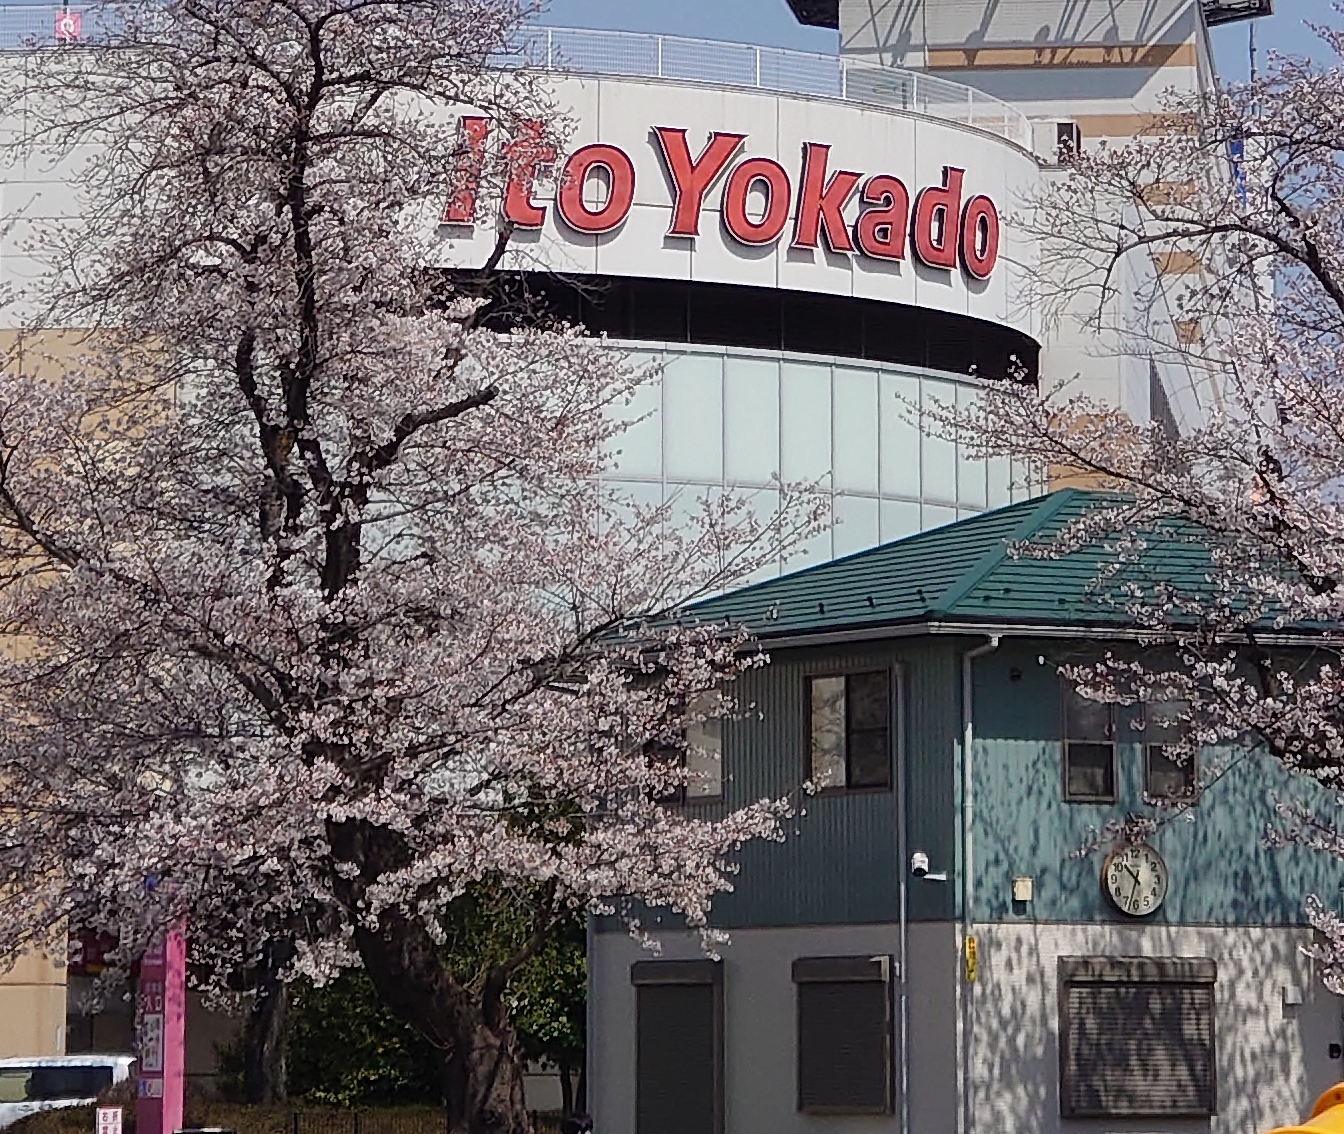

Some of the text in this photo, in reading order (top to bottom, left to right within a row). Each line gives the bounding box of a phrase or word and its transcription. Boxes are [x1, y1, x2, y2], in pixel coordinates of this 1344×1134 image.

[443, 115, 1000, 280] Ito Yokado
[1113, 862, 1123, 872] 10
[1133, 899, 1139, 910] 6
[1143, 896, 1150, 907] 5
